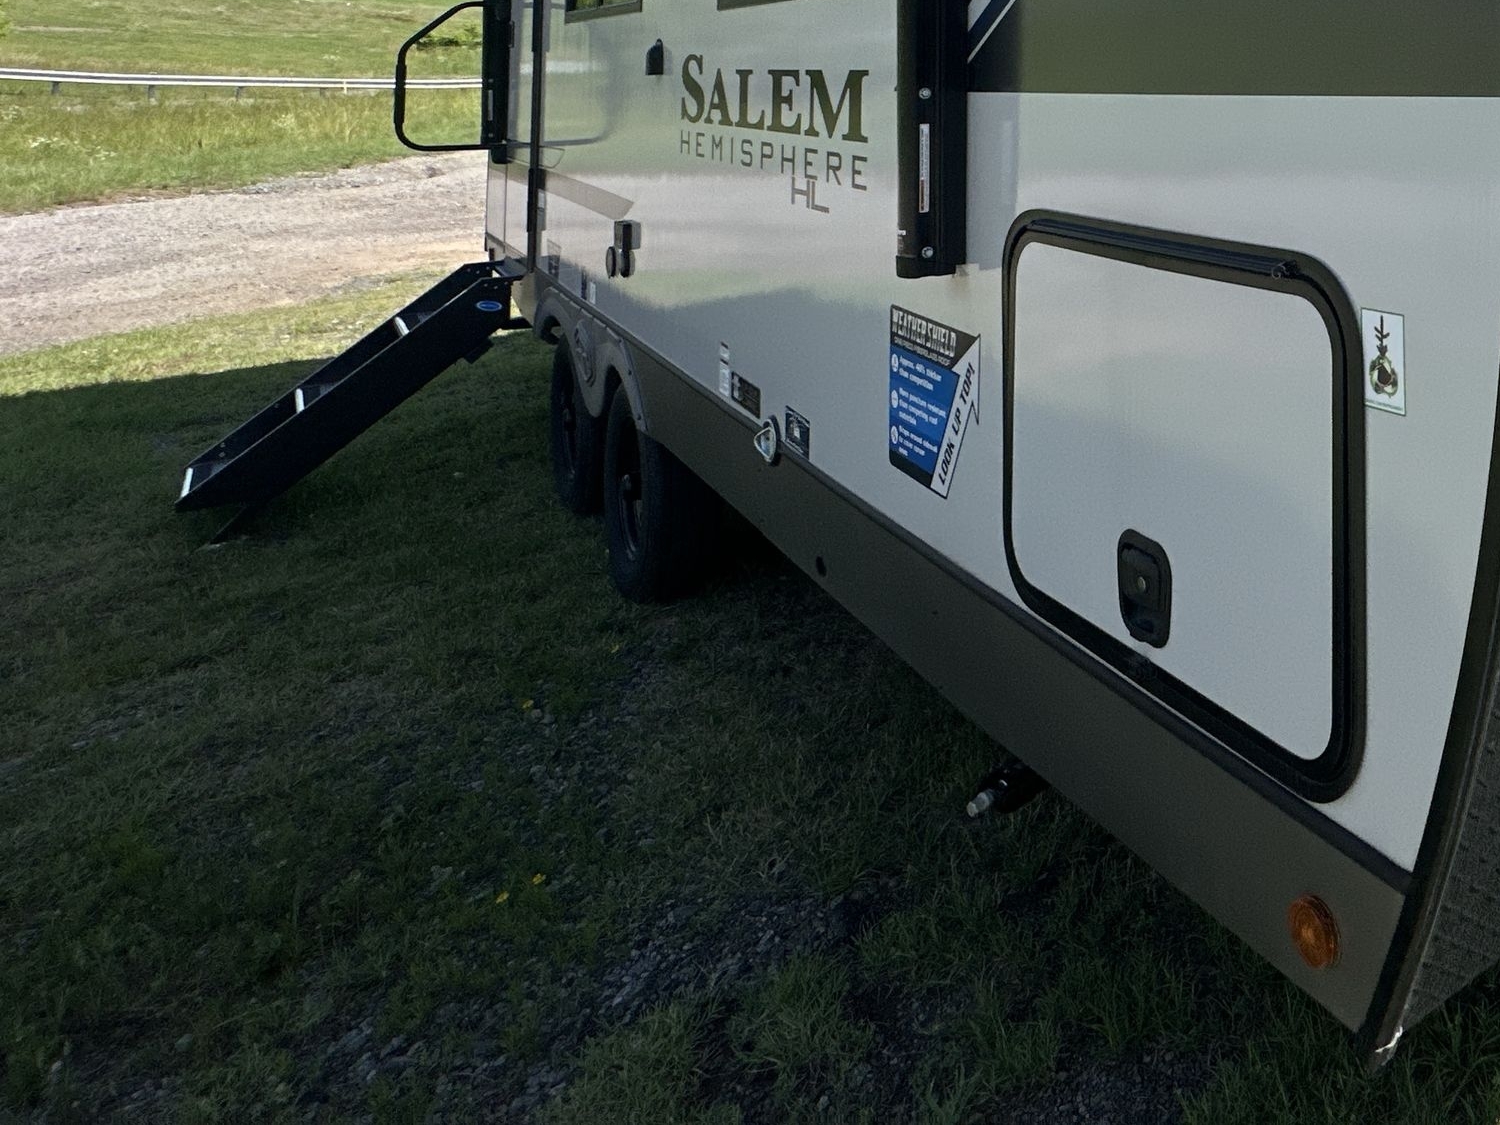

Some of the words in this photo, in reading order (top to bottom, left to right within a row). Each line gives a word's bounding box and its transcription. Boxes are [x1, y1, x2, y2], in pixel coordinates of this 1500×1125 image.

[680, 53, 869, 143] SALEM
[680, 130, 868, 191] HEMISPHERE
[939, 441, 955, 486] LOOK
[952, 407, 961, 435] UP
[960, 362, 975, 405] TOP!
